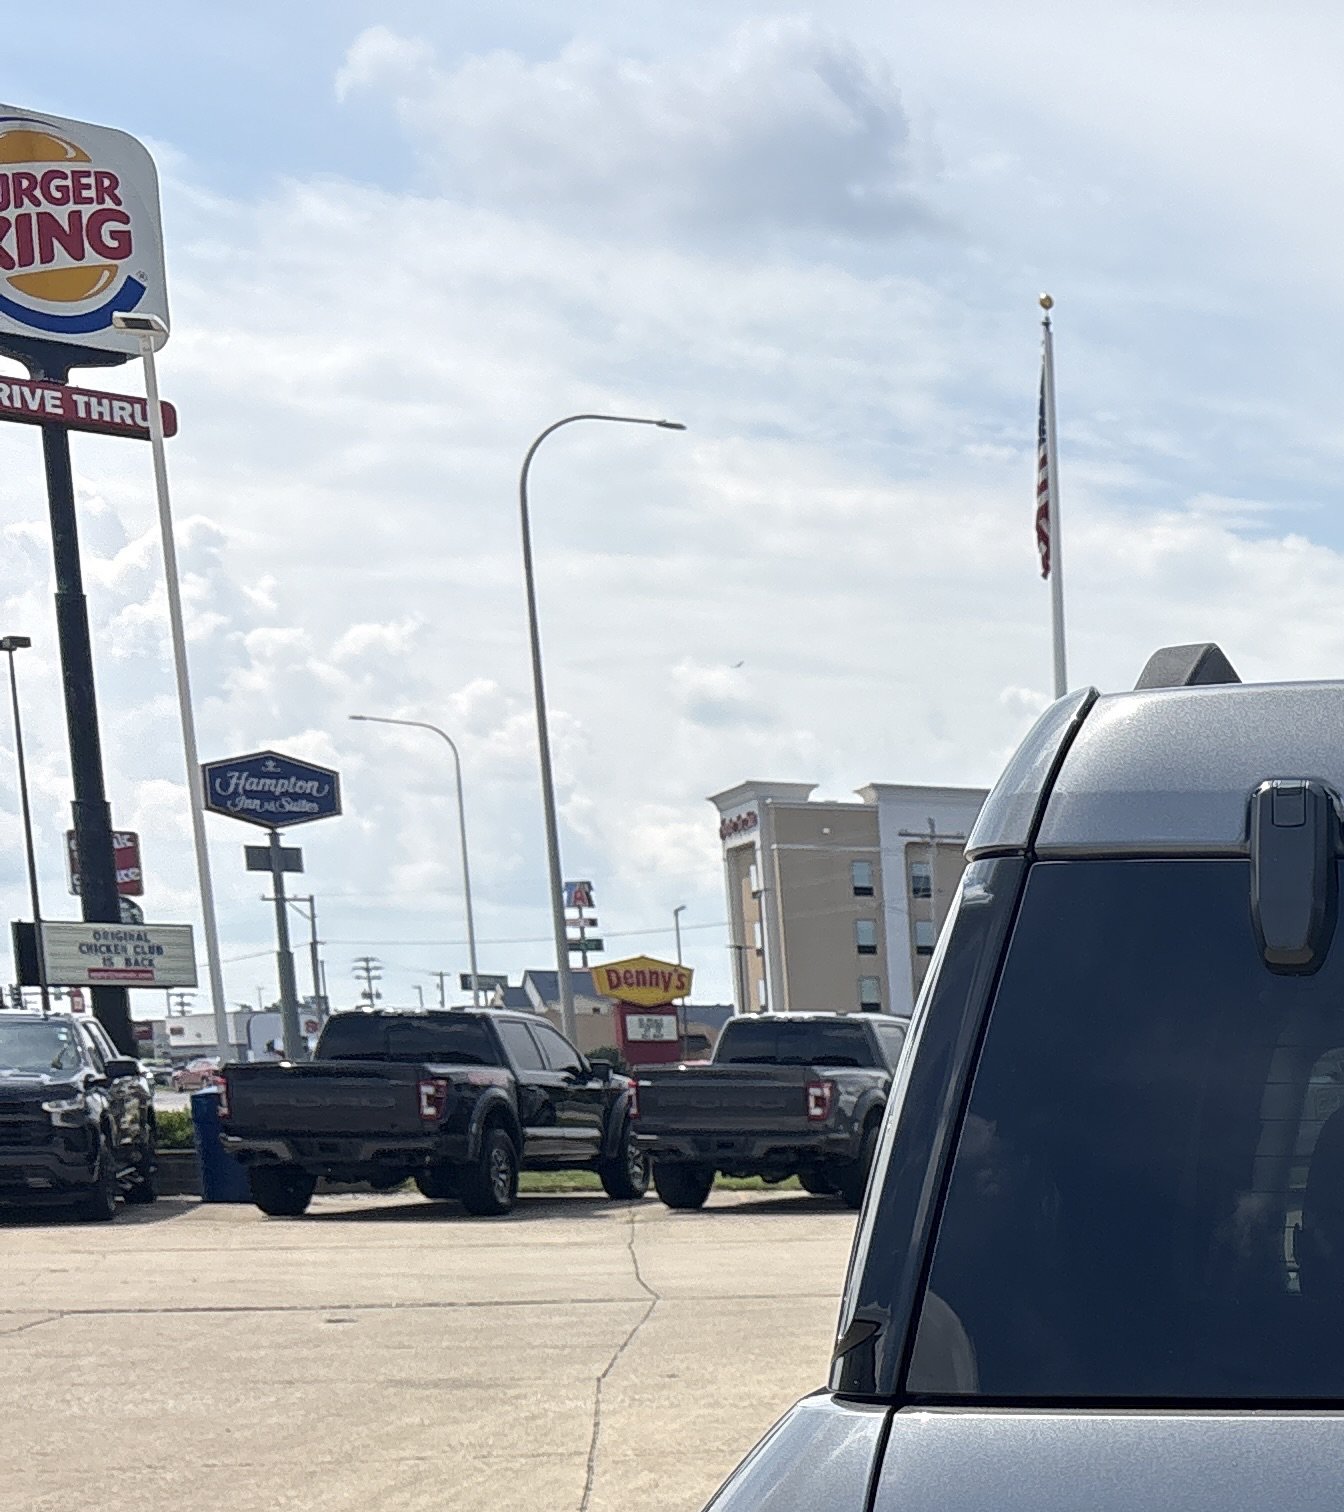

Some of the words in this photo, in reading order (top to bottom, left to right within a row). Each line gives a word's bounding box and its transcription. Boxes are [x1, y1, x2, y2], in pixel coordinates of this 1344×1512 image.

[71, 393, 151, 429] THRU
[215, 771, 330, 797] Hampton
[92, 929, 151, 943] ORIGINAL
[78, 942, 129, 956] CHICKEN
[132, 944, 164, 956] CLUB
[124, 956, 155, 967] BACK
[604, 966, 687, 993] Denny's
